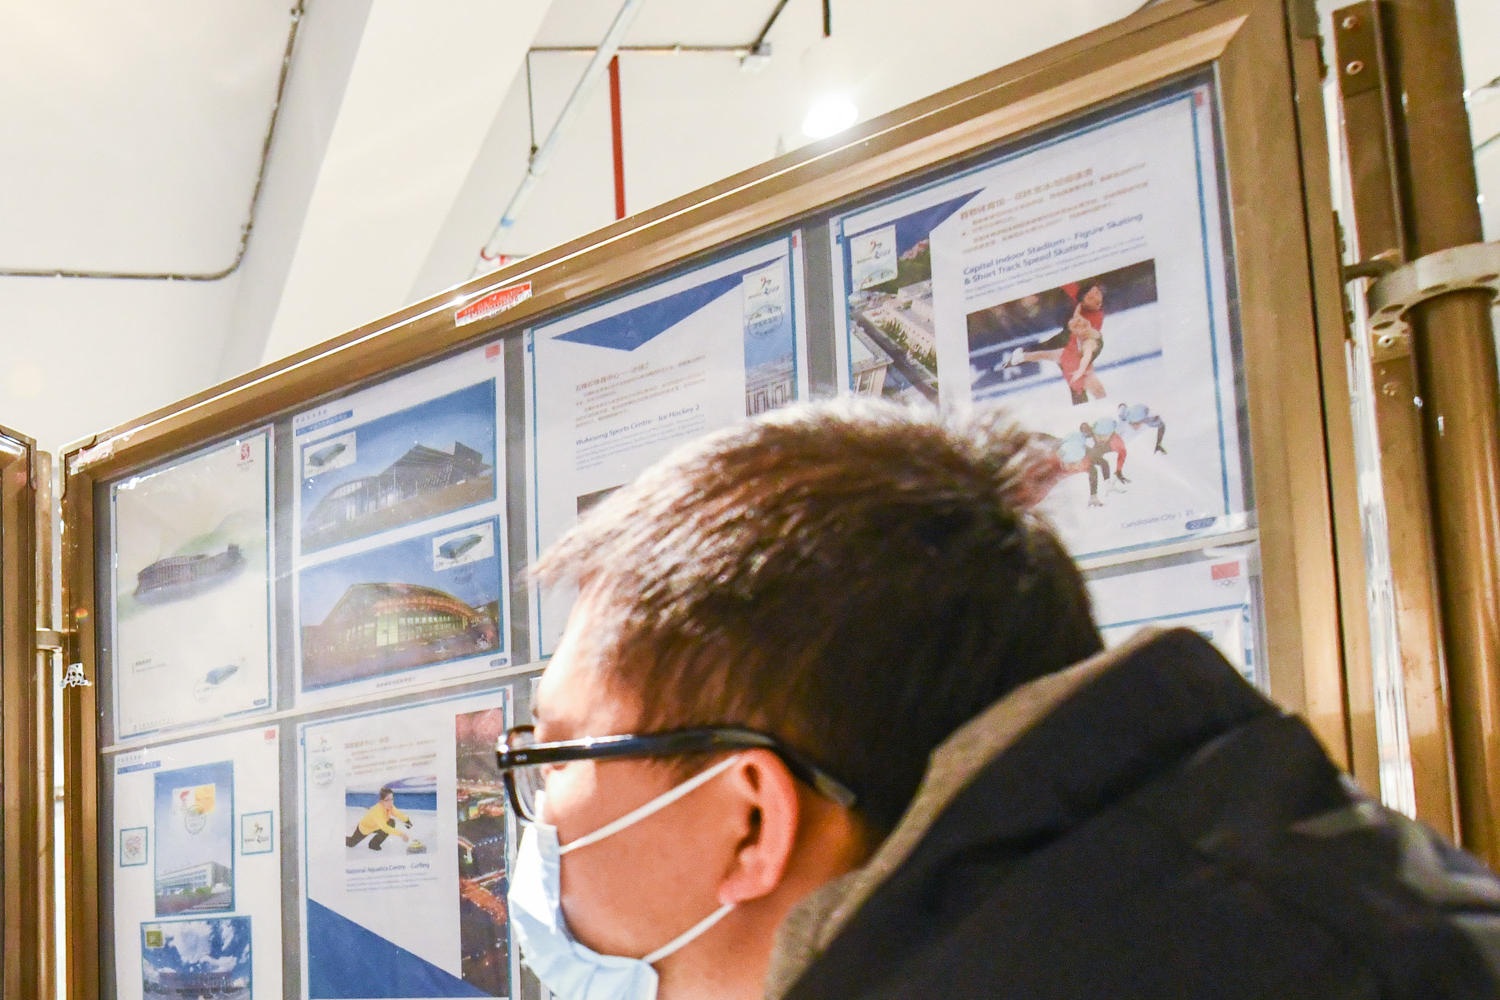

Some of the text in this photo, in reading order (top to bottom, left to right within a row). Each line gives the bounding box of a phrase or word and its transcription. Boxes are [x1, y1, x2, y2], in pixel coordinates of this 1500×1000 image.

[963, 259, 994, 276] Capital
[995, 251, 1026, 266] Indoor
[1027, 238, 1066, 255] Stadium
[1074, 226, 1104, 242] Figure
[1106, 212, 1143, 231] Skating
[972, 269, 997, 284] Short
[999, 261, 1021, 274] Track
[1023, 252, 1052, 269] Speed
[1053, 240, 1089, 258] Skating
[609, 424, 630, 437] Sports
[669, 407, 694, 419] Hockey
[367, 865, 389, 873] Aquatics
